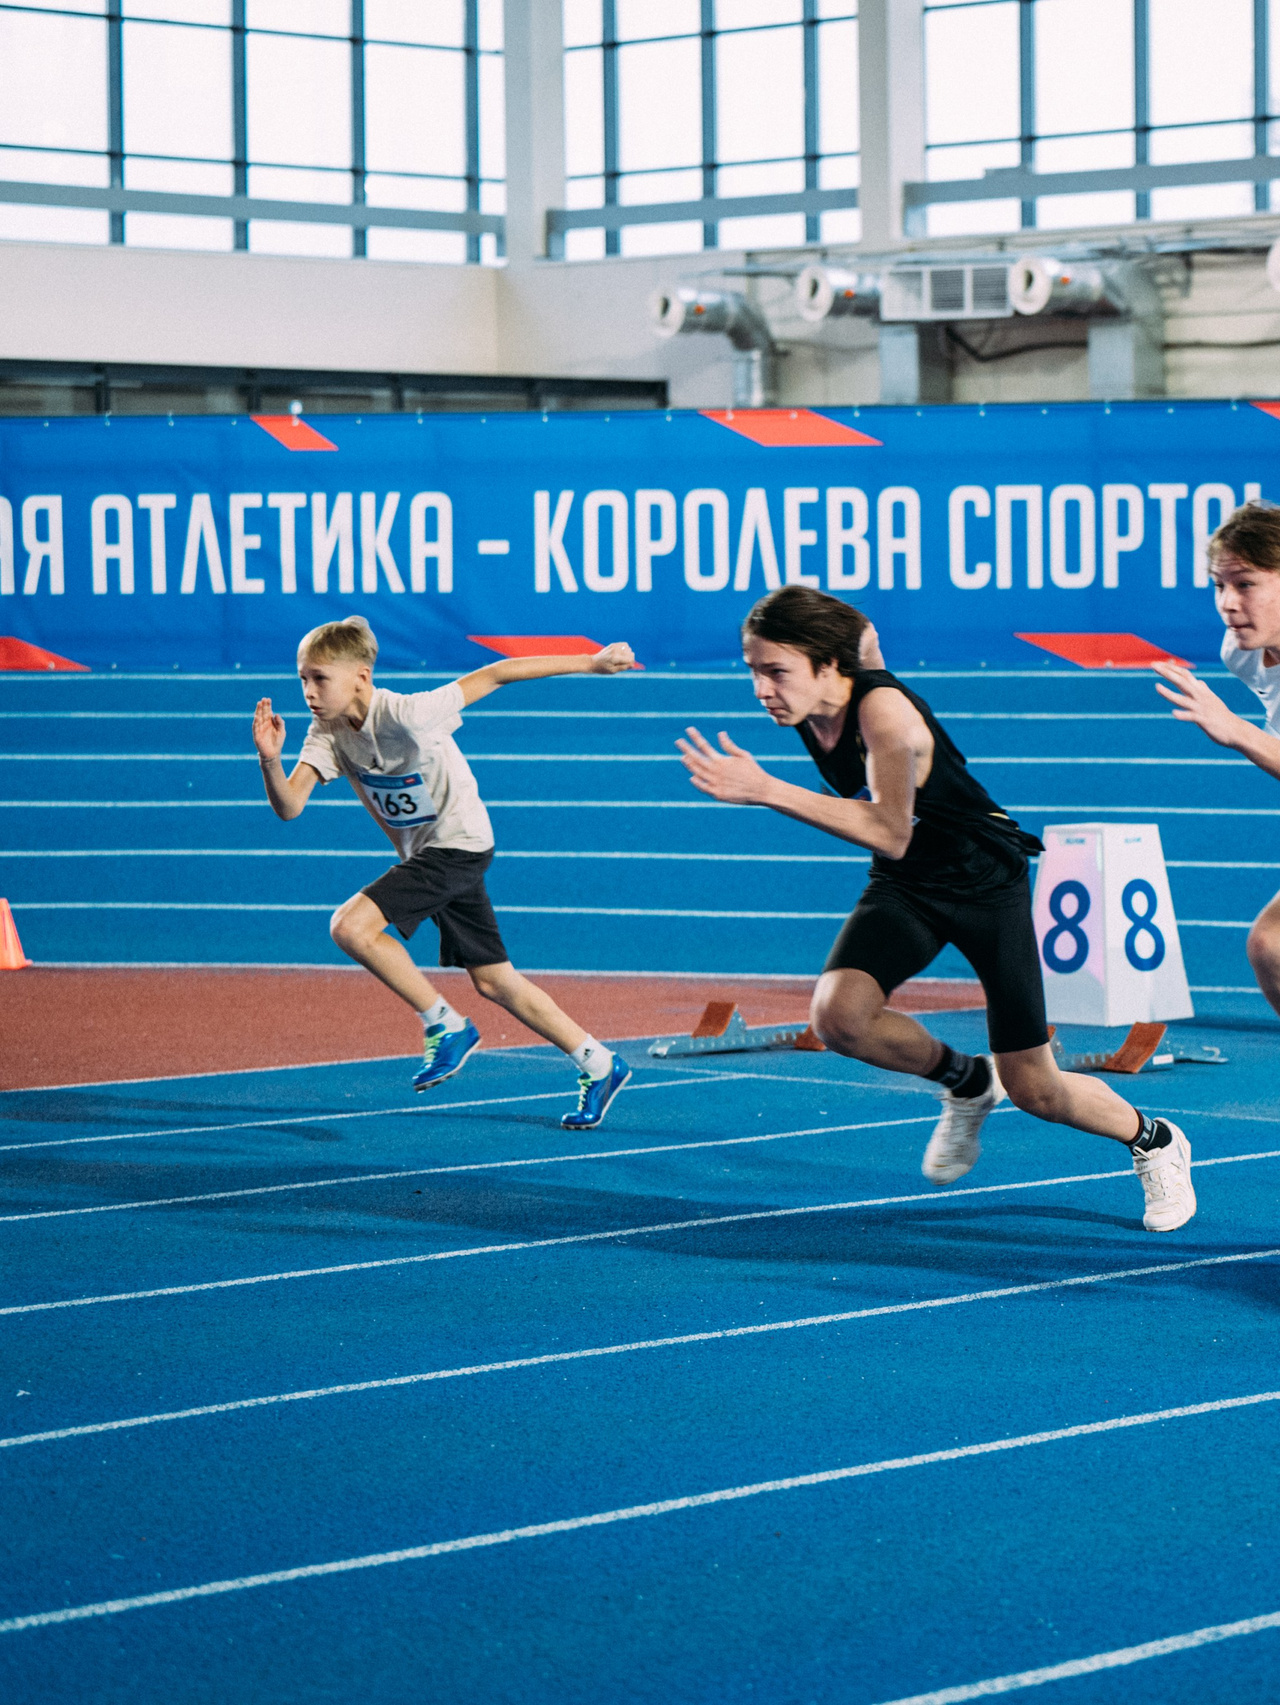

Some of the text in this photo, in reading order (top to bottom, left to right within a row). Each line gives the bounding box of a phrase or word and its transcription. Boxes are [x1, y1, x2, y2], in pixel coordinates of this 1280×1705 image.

[91, 492, 453, 596] АТЛЕТИКА
[534, 484, 922, 593] КОРОЛЕВА
[948, 483, 1261, 589] СПОРТА
[371, 791, 418, 818] 163
[1042, 879, 1091, 975] 8
[1121, 878, 1166, 972] 8
